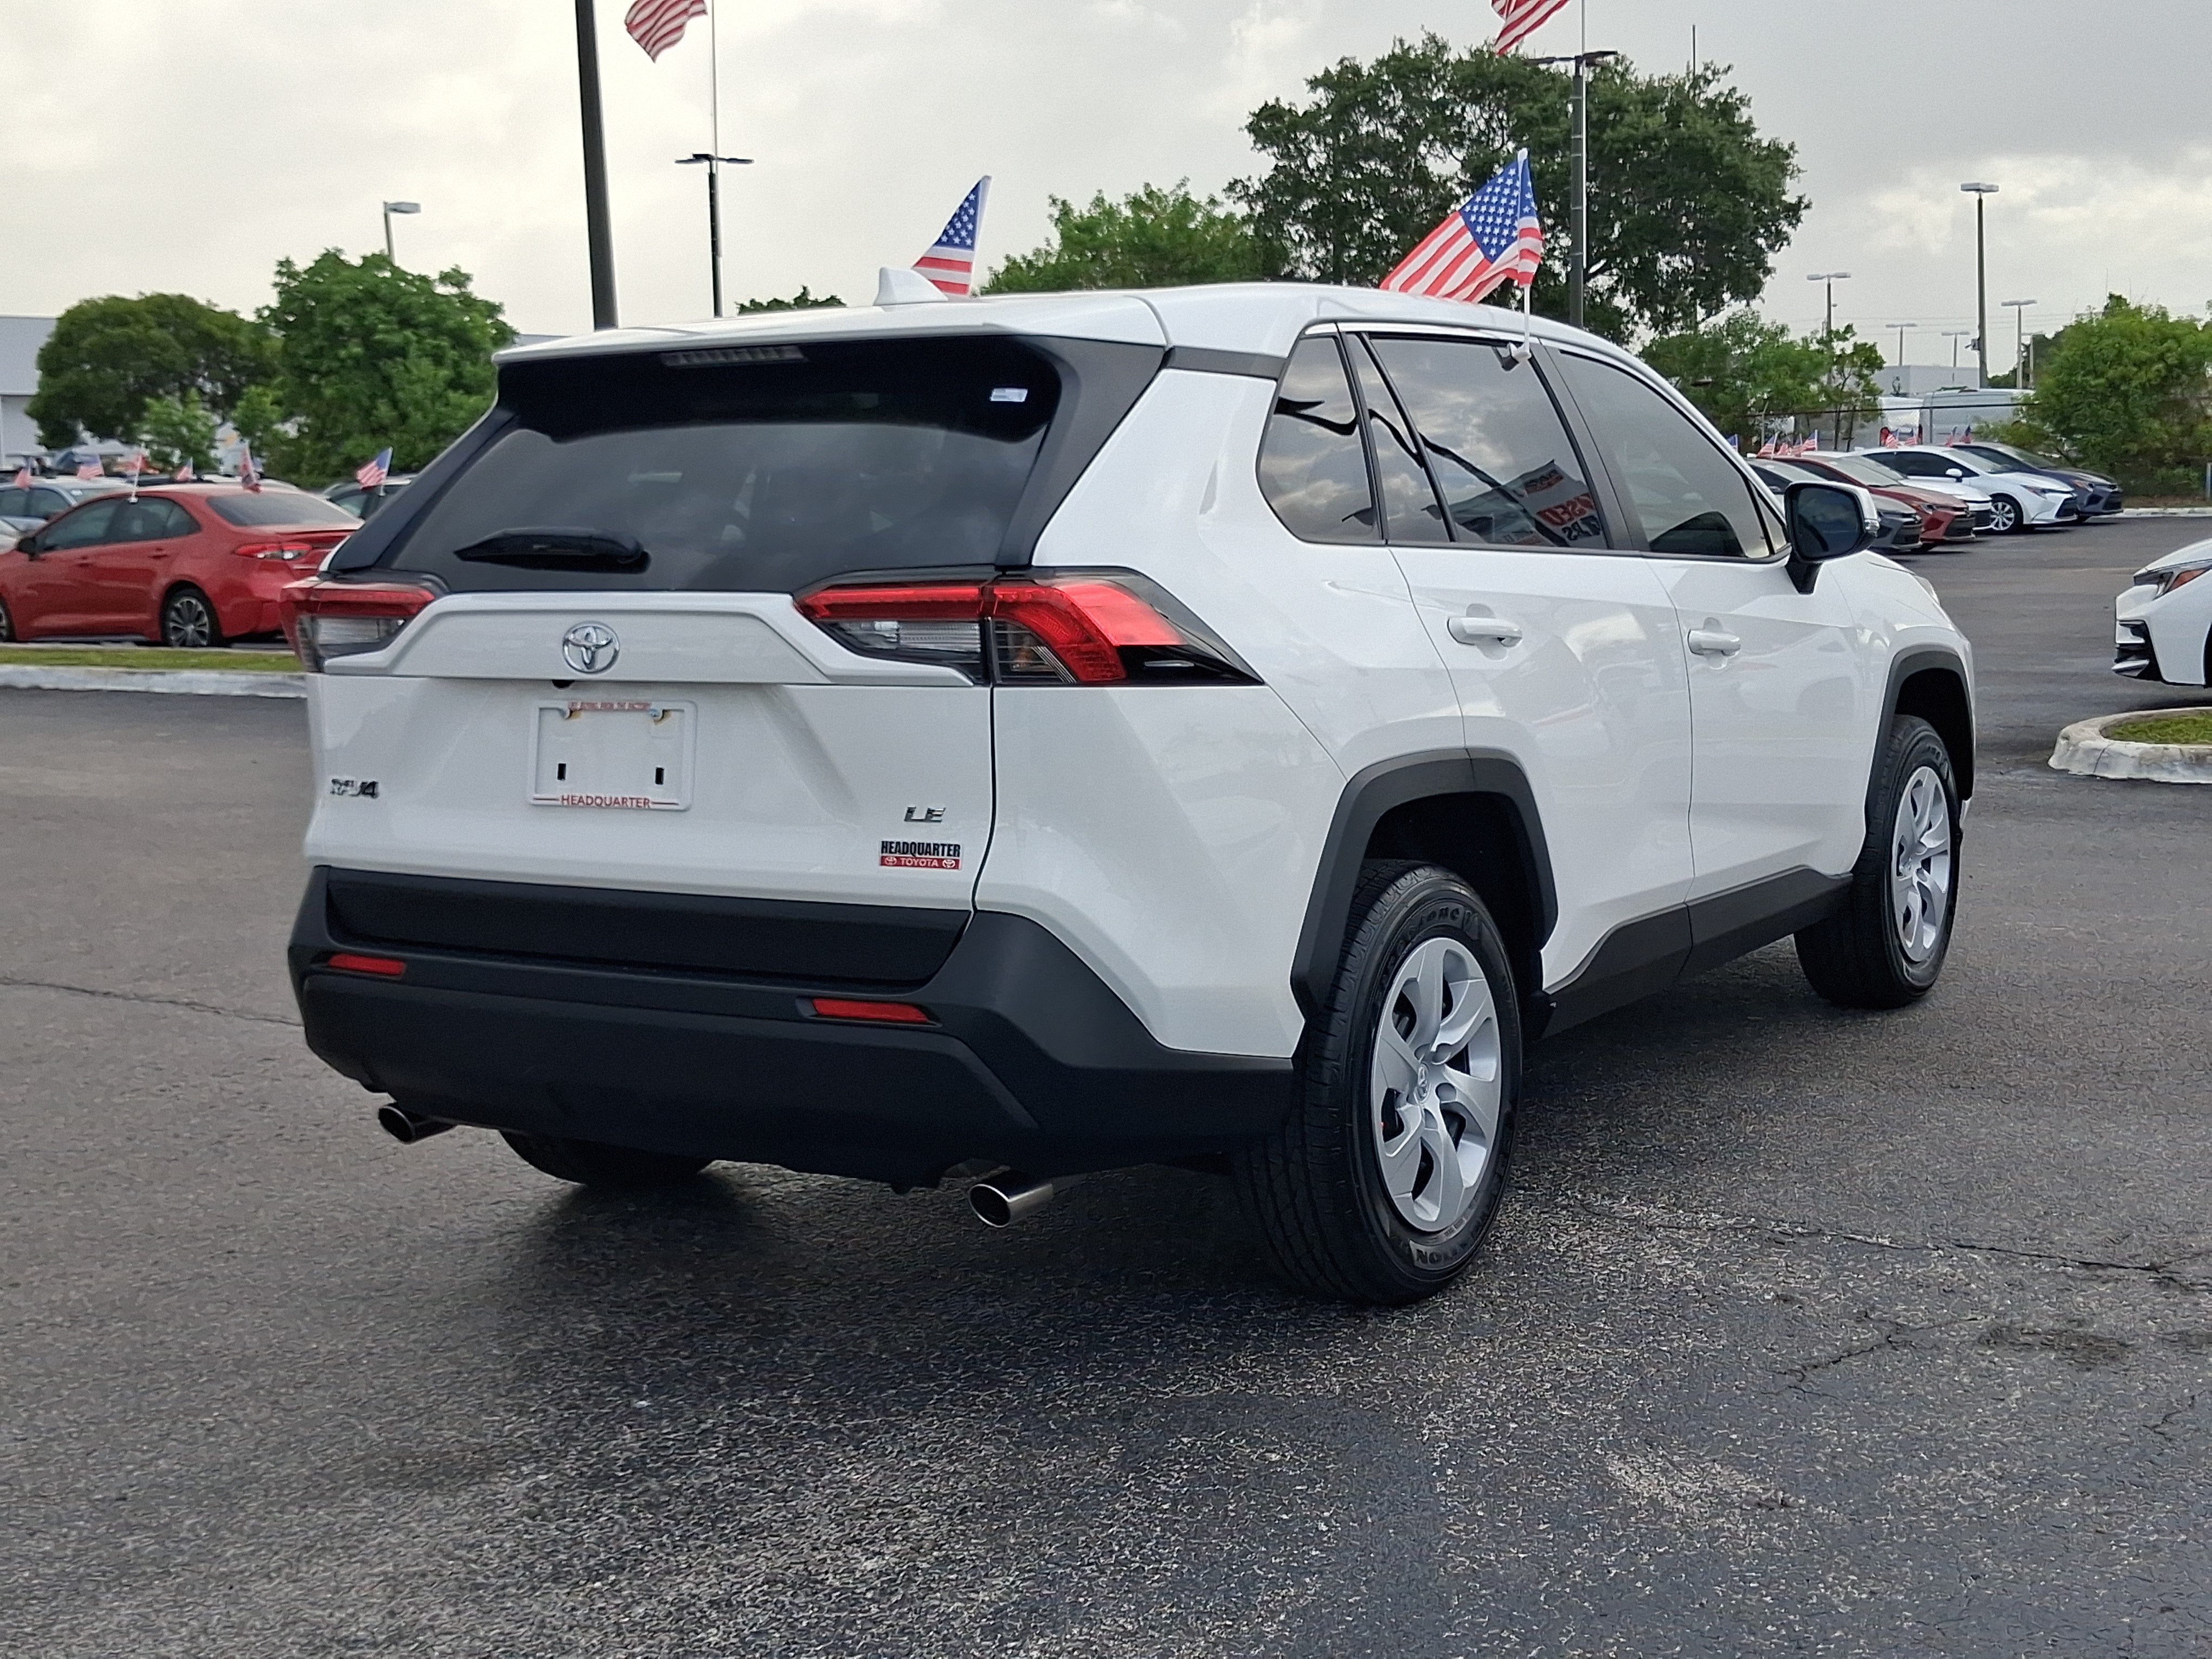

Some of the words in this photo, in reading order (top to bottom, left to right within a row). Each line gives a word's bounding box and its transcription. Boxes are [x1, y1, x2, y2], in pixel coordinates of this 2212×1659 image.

[561, 795, 651, 807] HEADQUARTER
[904, 806, 946, 822] LE
[881, 840, 961, 857] HEADQUARTER
[899, 858, 939, 867] TOYOTA
